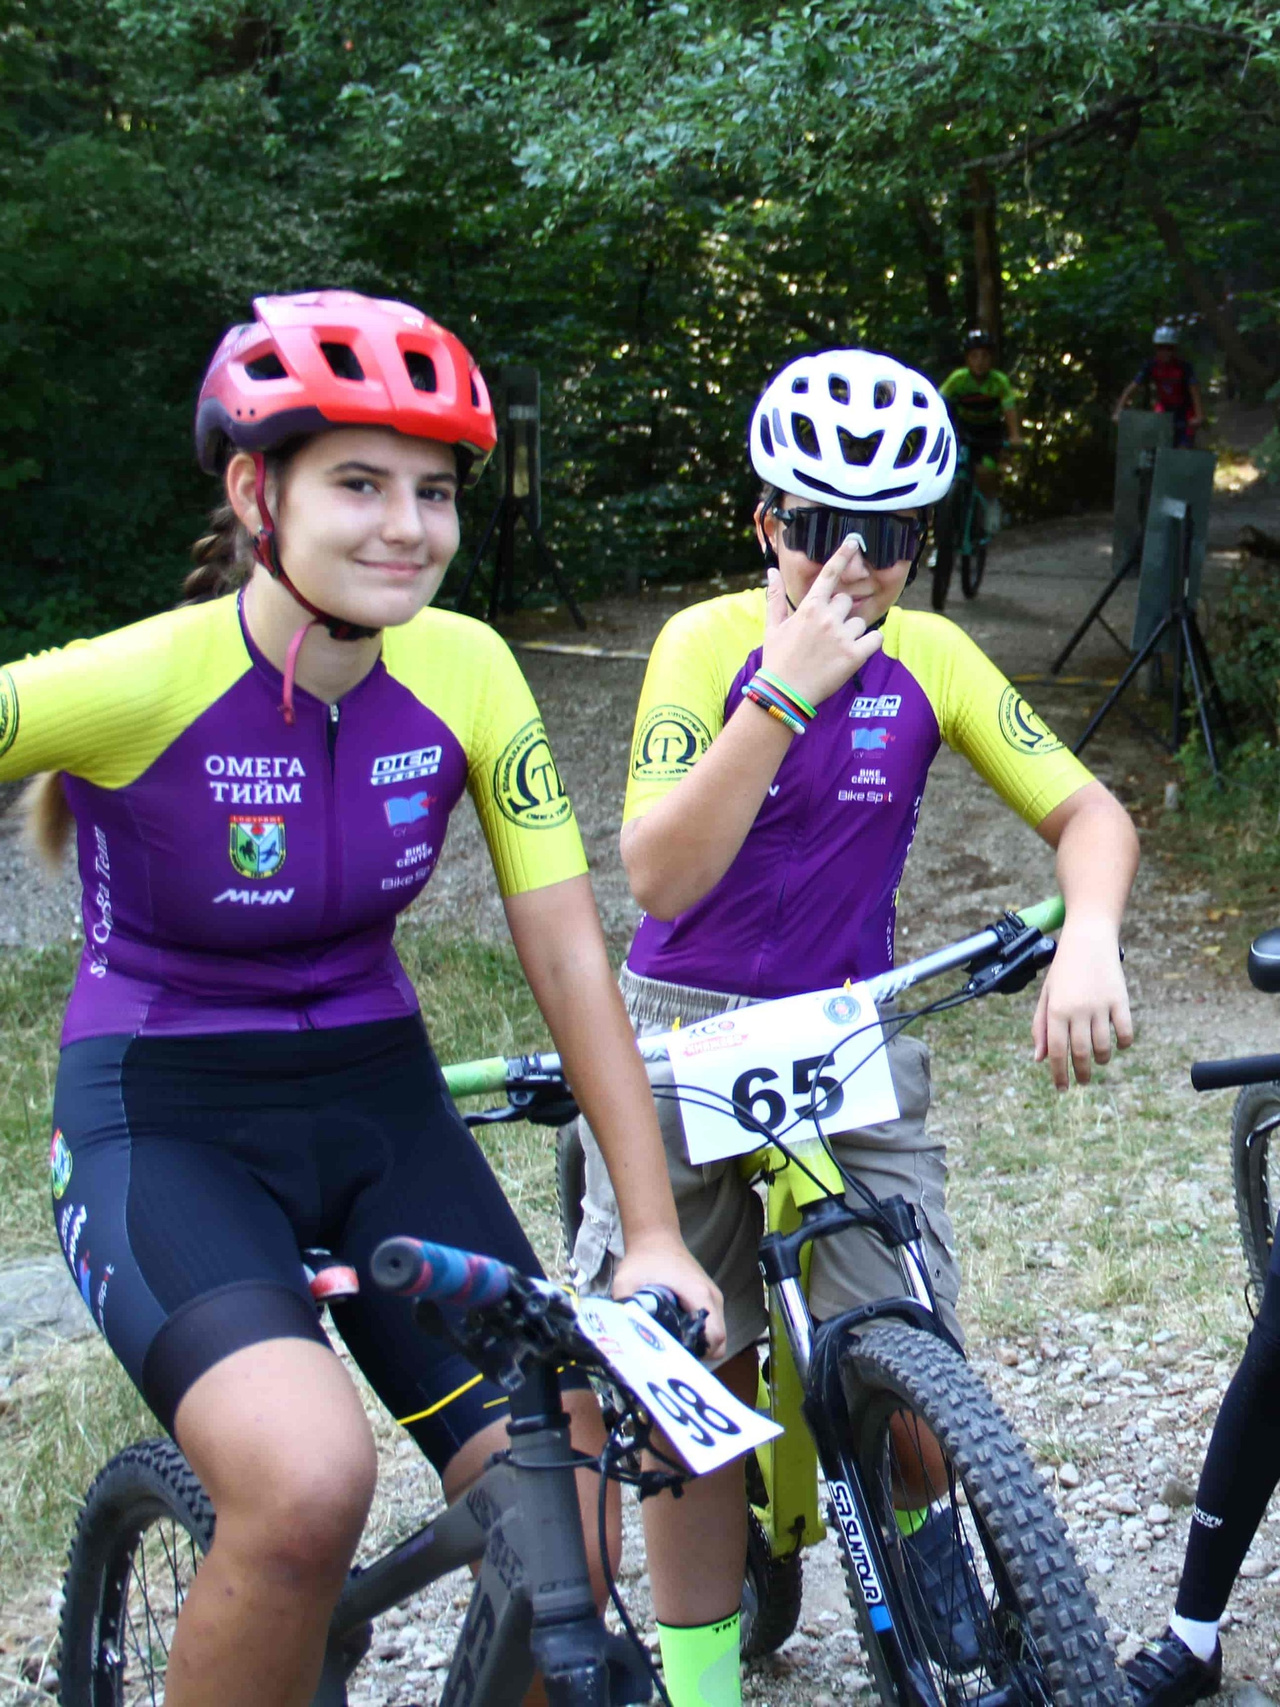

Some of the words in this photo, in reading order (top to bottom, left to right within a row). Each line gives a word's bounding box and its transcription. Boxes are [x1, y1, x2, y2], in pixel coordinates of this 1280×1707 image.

[205, 755, 306, 778] ОМЕГА
[860, 768, 881, 777] BIKE
[852, 775, 886, 785] CENTER
[209, 779, 302, 804] ТИЙМ
[838, 789, 865, 801] Bike
[396, 847, 433, 868] CENTER
[405, 842, 428, 858] BIKE
[732, 1054, 845, 1133] 65
[647, 1378, 741, 1447] 98
[842, 1519, 880, 1600] SUNTOUR
